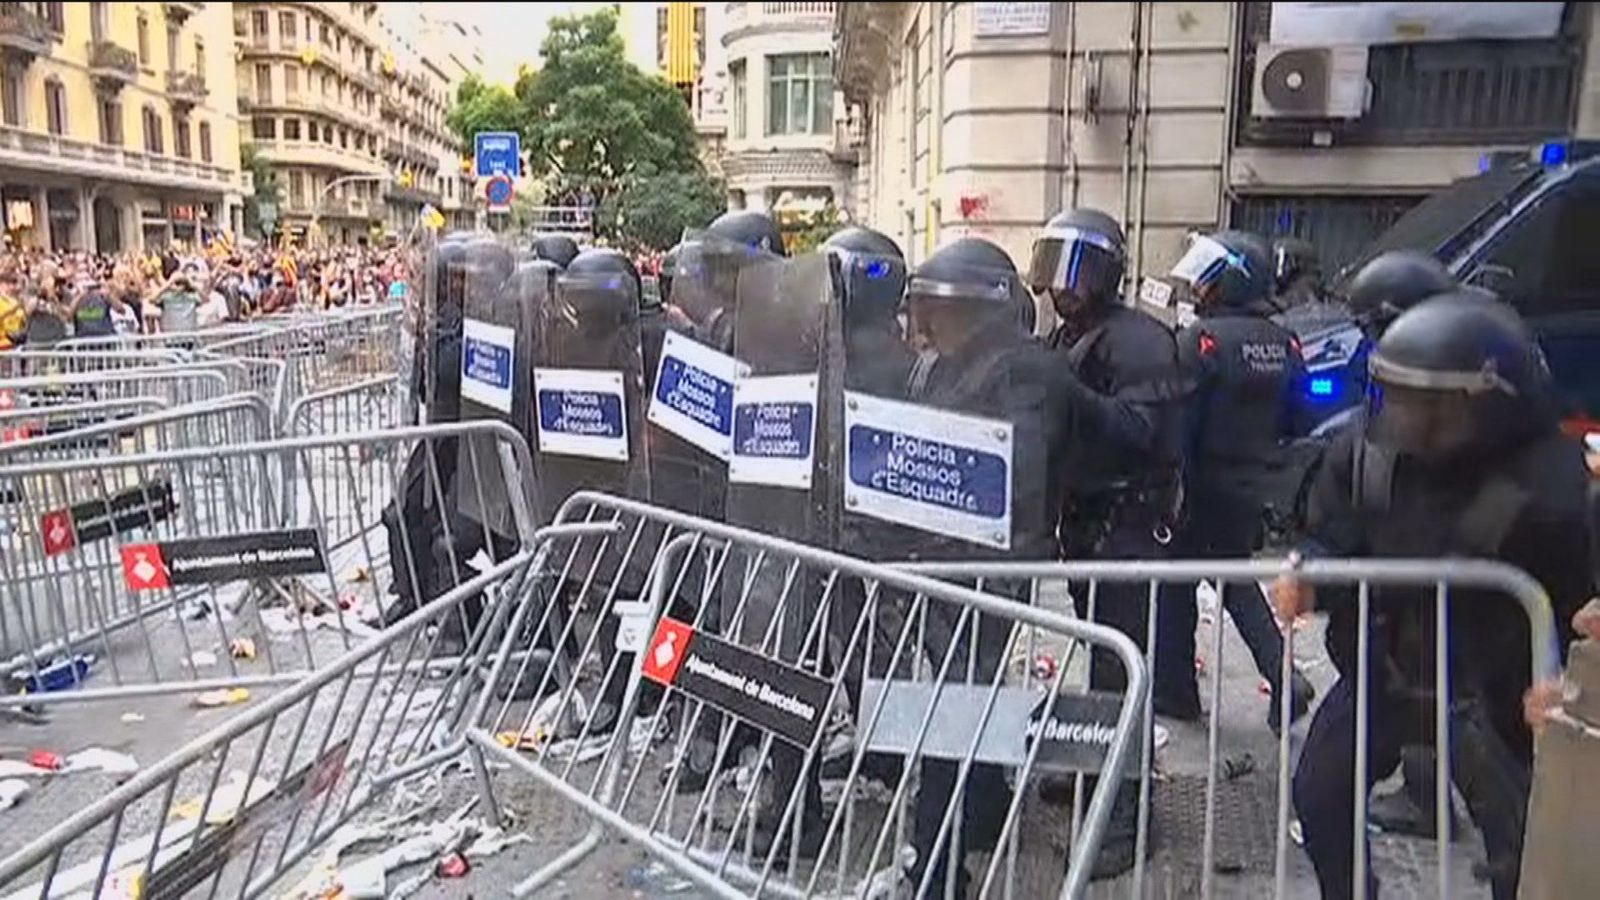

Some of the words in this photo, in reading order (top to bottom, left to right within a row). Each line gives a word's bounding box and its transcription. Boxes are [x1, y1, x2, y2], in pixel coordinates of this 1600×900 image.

[892, 433, 957, 466] Policia
[887, 451, 962, 487] Mossos
[685, 652, 746, 692] Ajuntament
[745, 678, 760, 698] de
[759, 681, 816, 721] Barcelona
[1044, 716, 1118, 744] Barcelon
